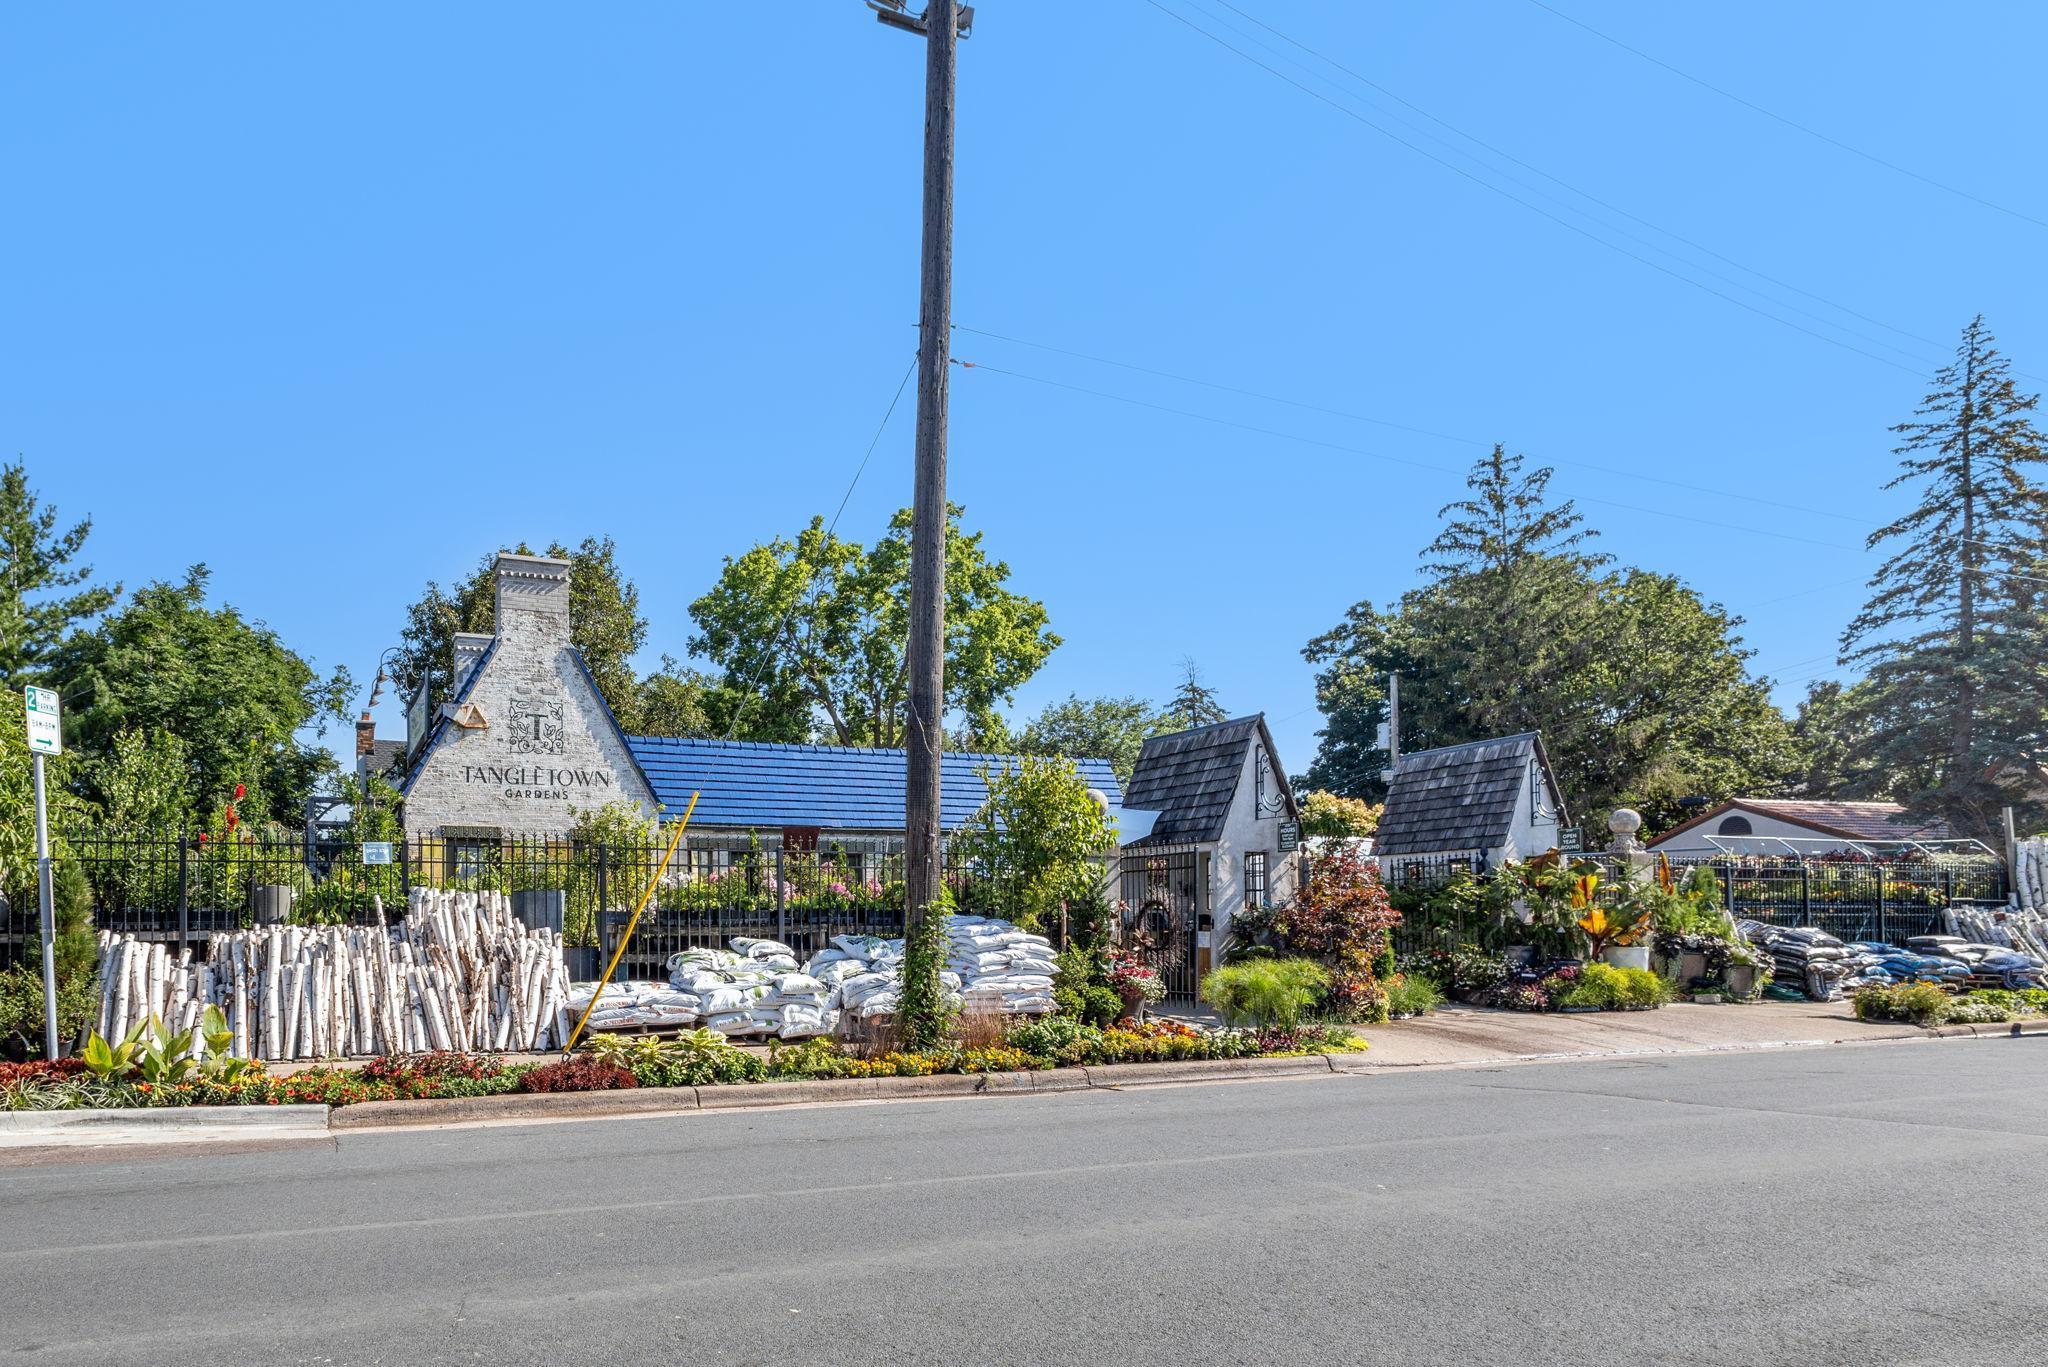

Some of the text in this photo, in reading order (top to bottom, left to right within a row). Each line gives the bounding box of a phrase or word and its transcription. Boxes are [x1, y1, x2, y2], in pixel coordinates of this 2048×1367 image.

[27, 691, 36, 708] 2
[524, 713, 549, 741] T
[462, 765, 610, 788] TANGLETOWN
[505, 788, 569, 800] GARDENS
